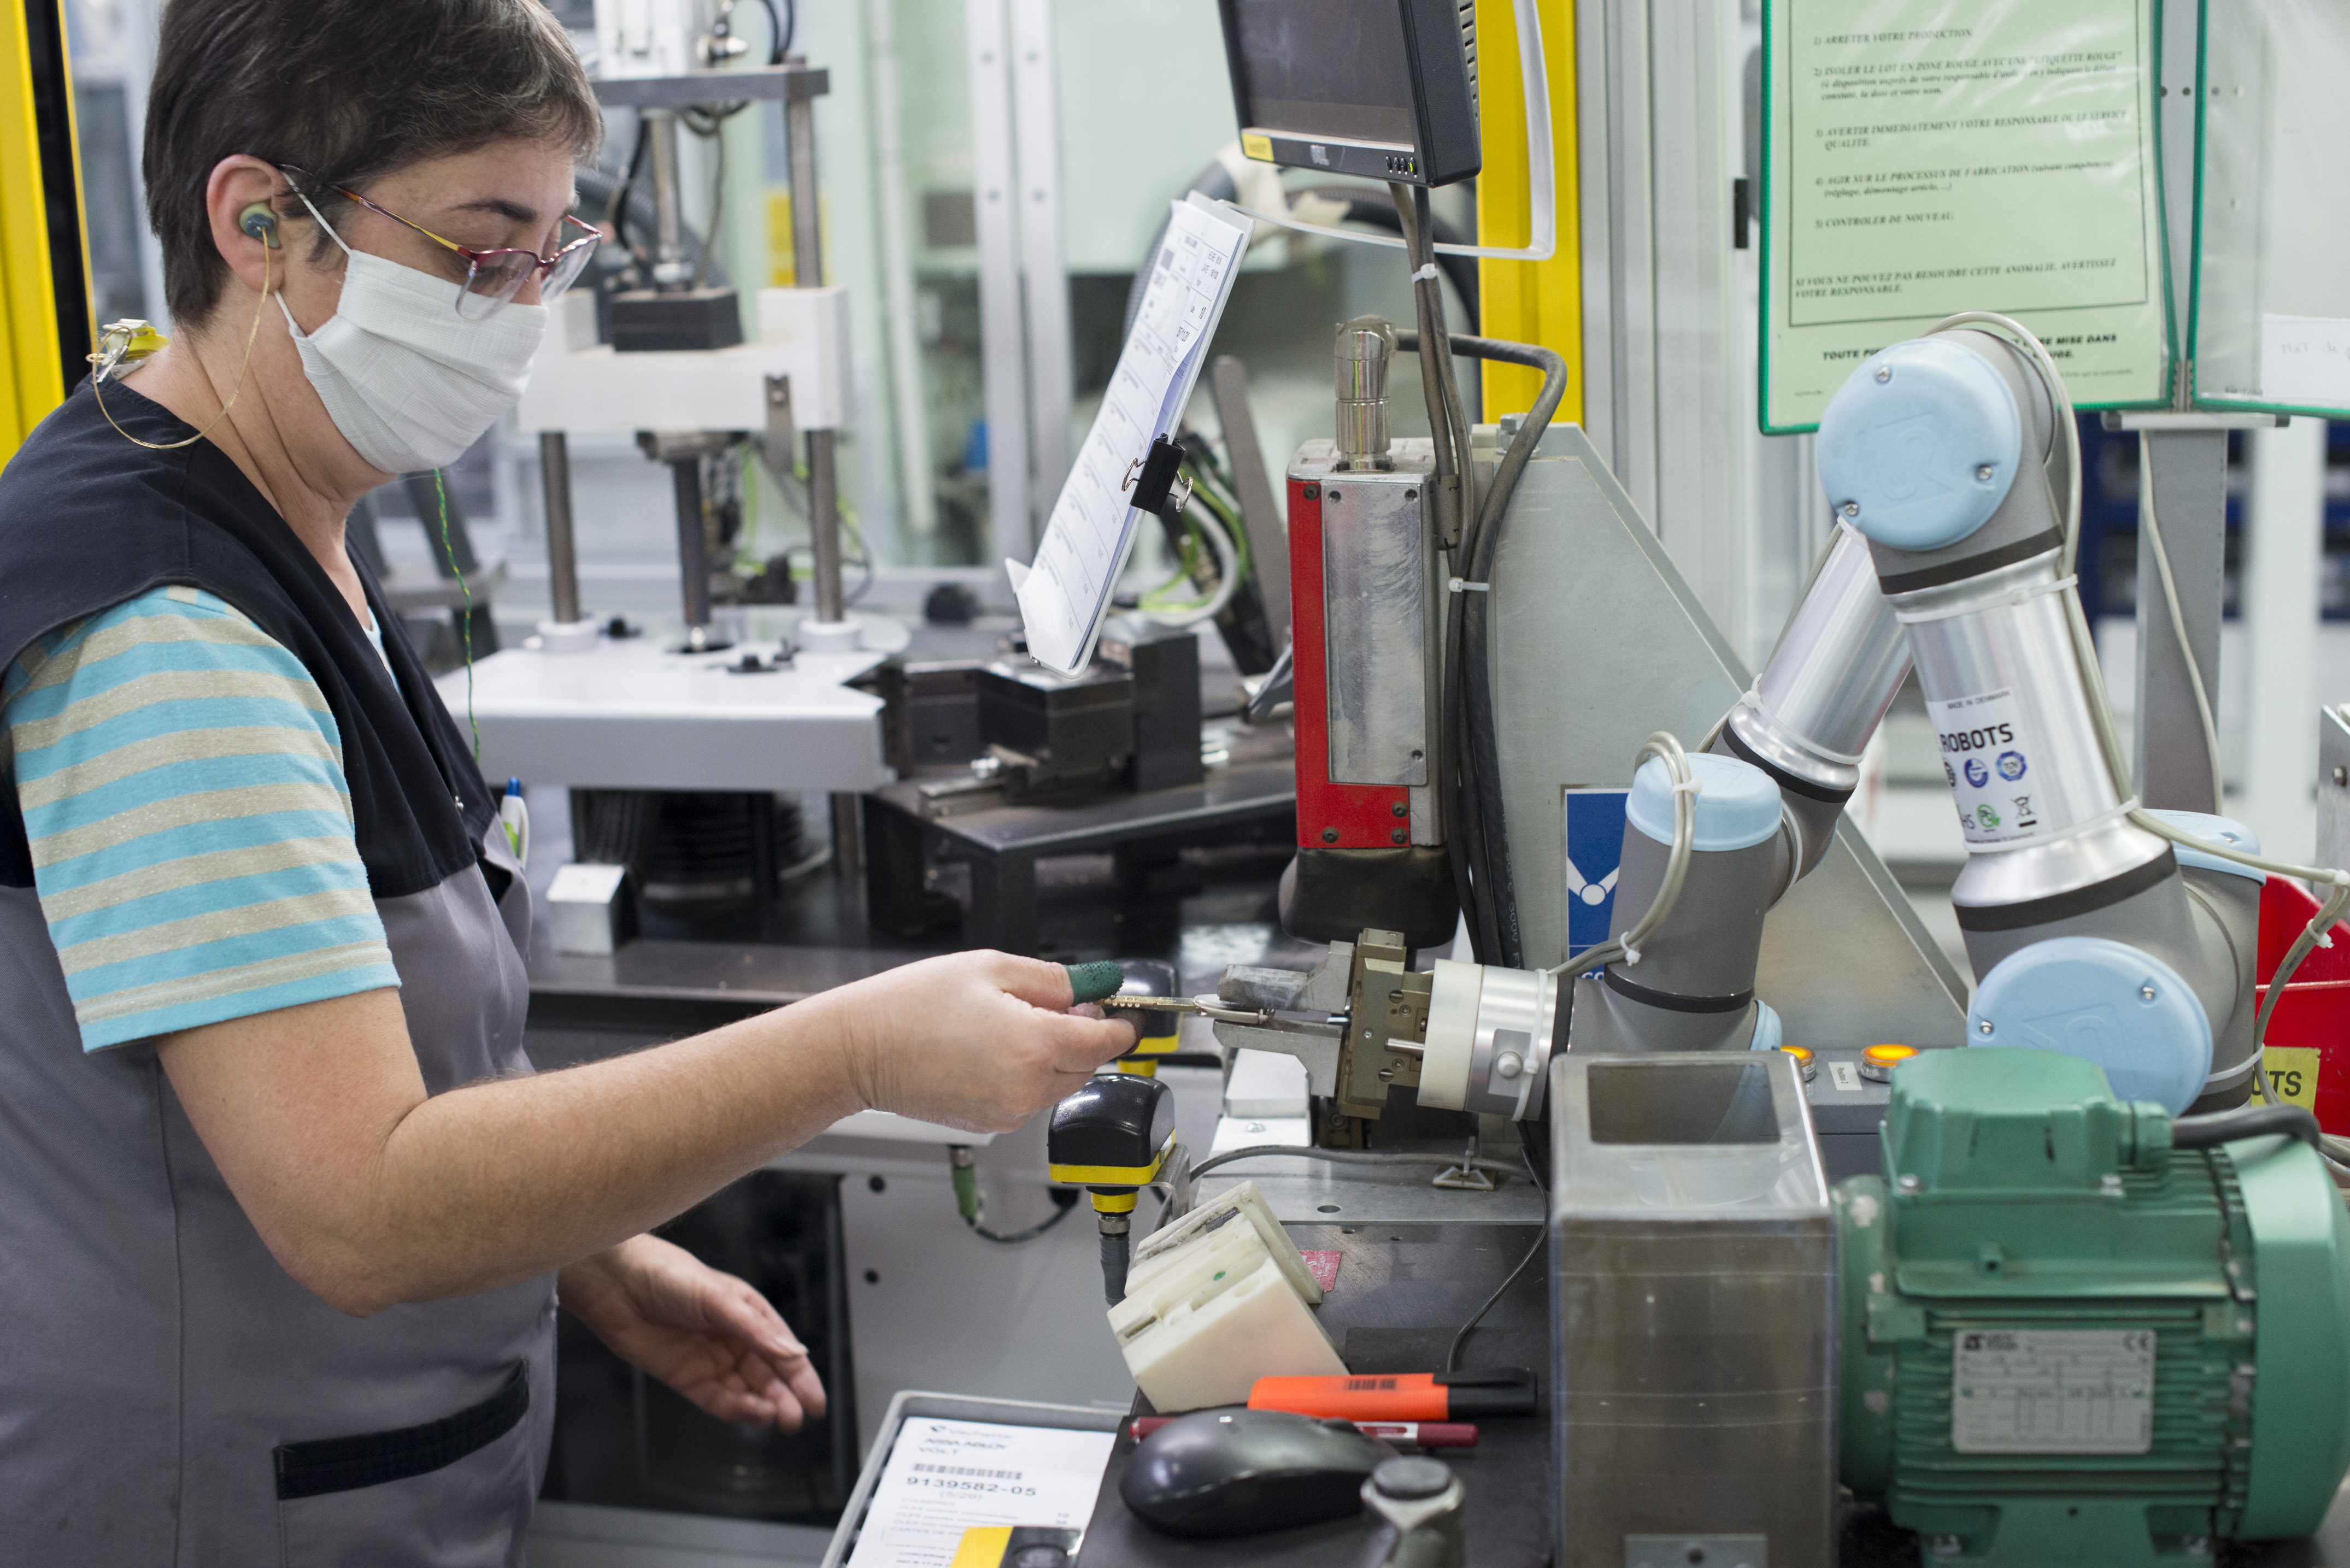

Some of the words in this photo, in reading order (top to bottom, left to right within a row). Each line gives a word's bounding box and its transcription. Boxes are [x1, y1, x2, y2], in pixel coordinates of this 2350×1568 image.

[1822, 349, 1860, 361] TOUTE
[2056, 334, 2084, 346] MISE
[2086, 333, 2117, 344] DANS
[1946, 700, 1964, 710] MADE
[1940, 722, 2014, 753] ROBOTS
[1508, 902, 1518, 943] 300V
[906, 1476, 1037, 1497] 9139582-05
